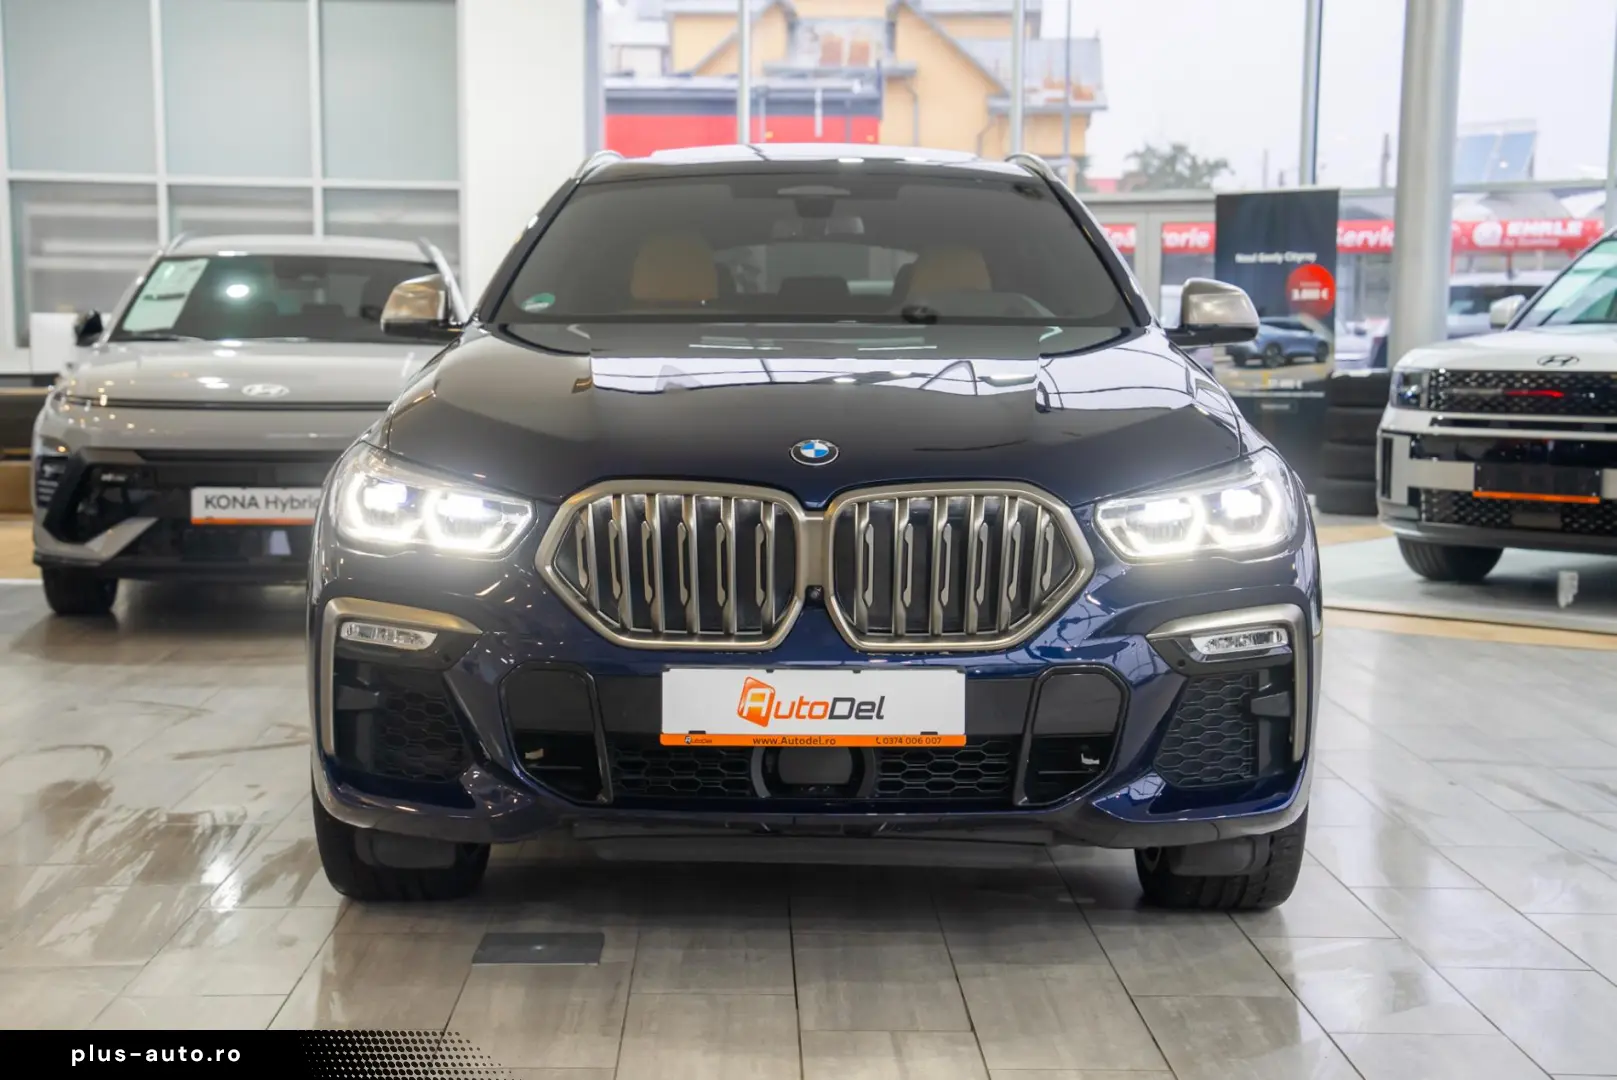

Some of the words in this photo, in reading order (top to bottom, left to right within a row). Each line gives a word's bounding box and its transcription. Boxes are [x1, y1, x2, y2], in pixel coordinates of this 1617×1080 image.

[204, 494, 260, 510] KONA
[741, 686, 885, 721] AutoDel
[752, 735, 837, 746] www.Autodel.ro
[882, 736, 903, 745] 0374
